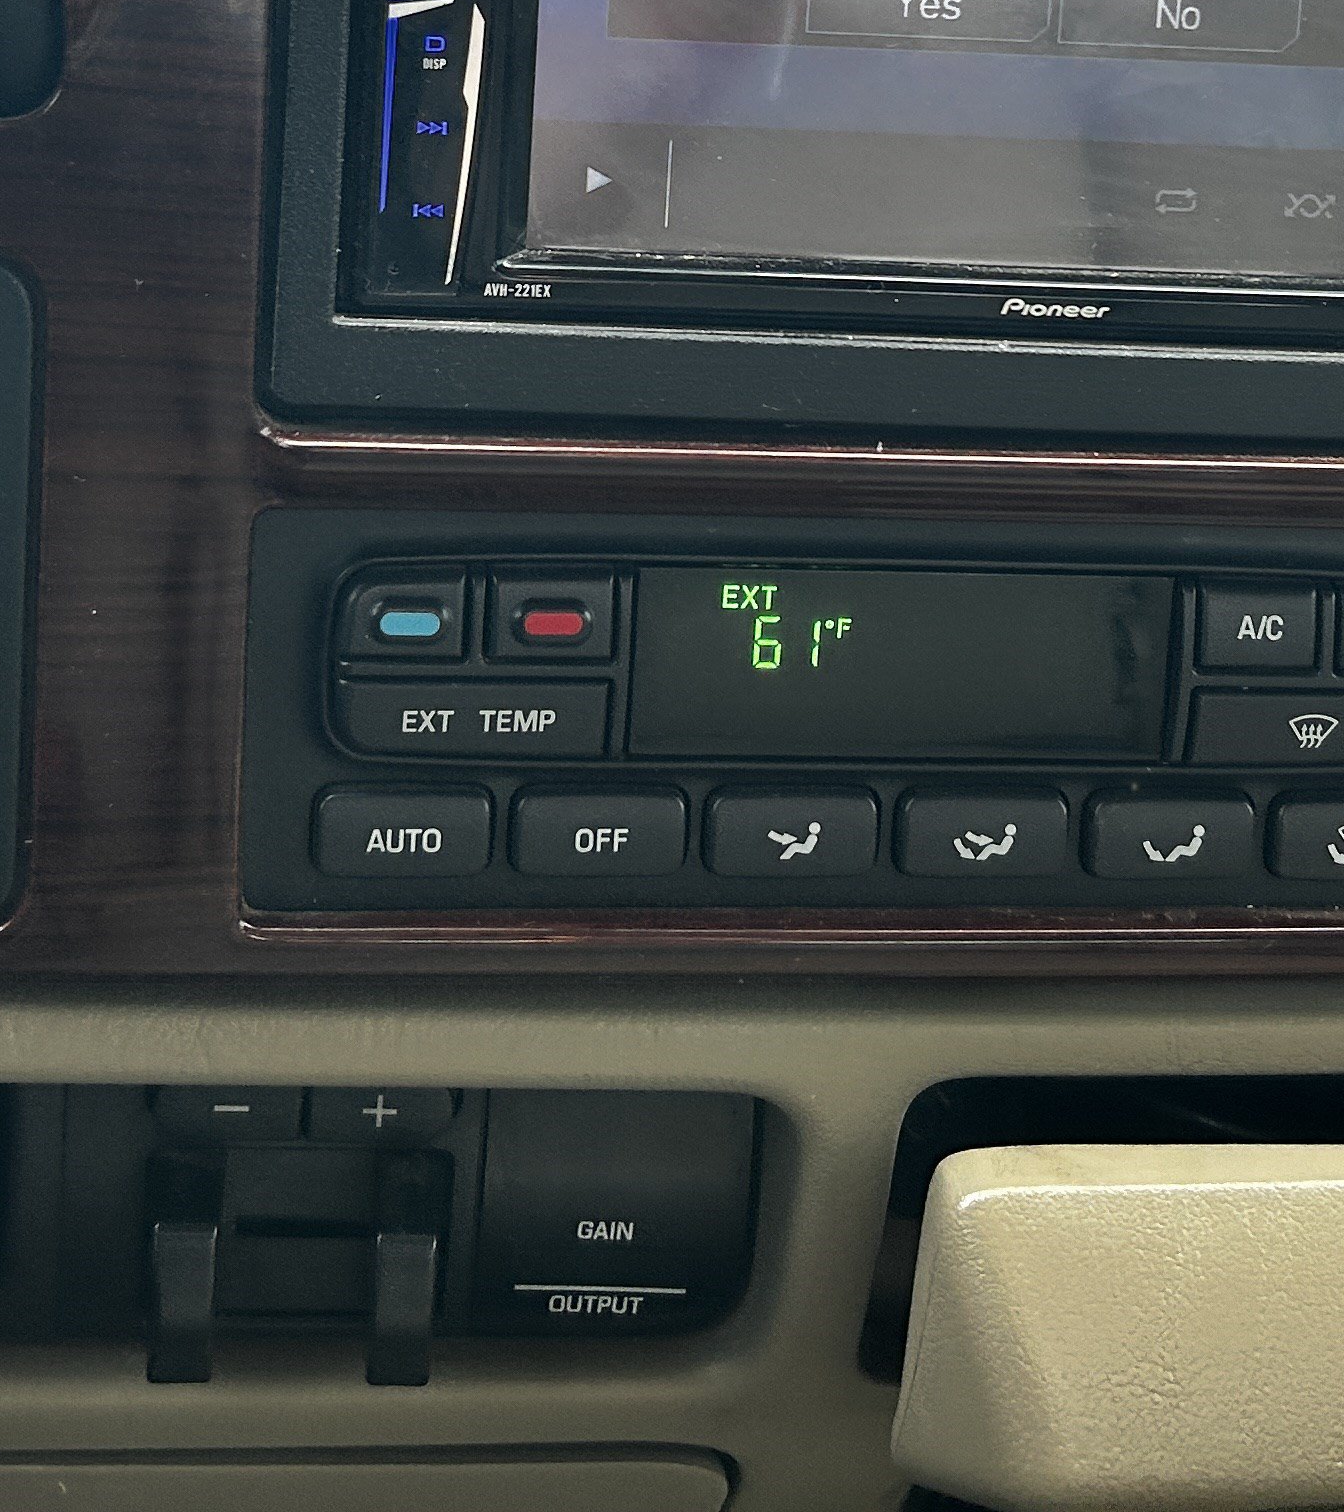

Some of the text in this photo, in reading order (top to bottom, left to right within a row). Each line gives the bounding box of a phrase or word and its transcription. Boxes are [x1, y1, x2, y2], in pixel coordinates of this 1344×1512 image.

[422, 57, 447, 70] DISP
[483, 283, 553, 299] AVH-221EX
[1000, 297, 1111, 319] Pioneer
[722, 584, 778, 610] EXT
[1237, 614, 1284, 641] A/C
[402, 709, 556, 733] EXT TEMP
[366, 827, 442, 853] AUTO
[574, 828, 629, 853] OFF
[577, 1220, 634, 1241] GAIN
[548, 1294, 644, 1315] OUTPUT
